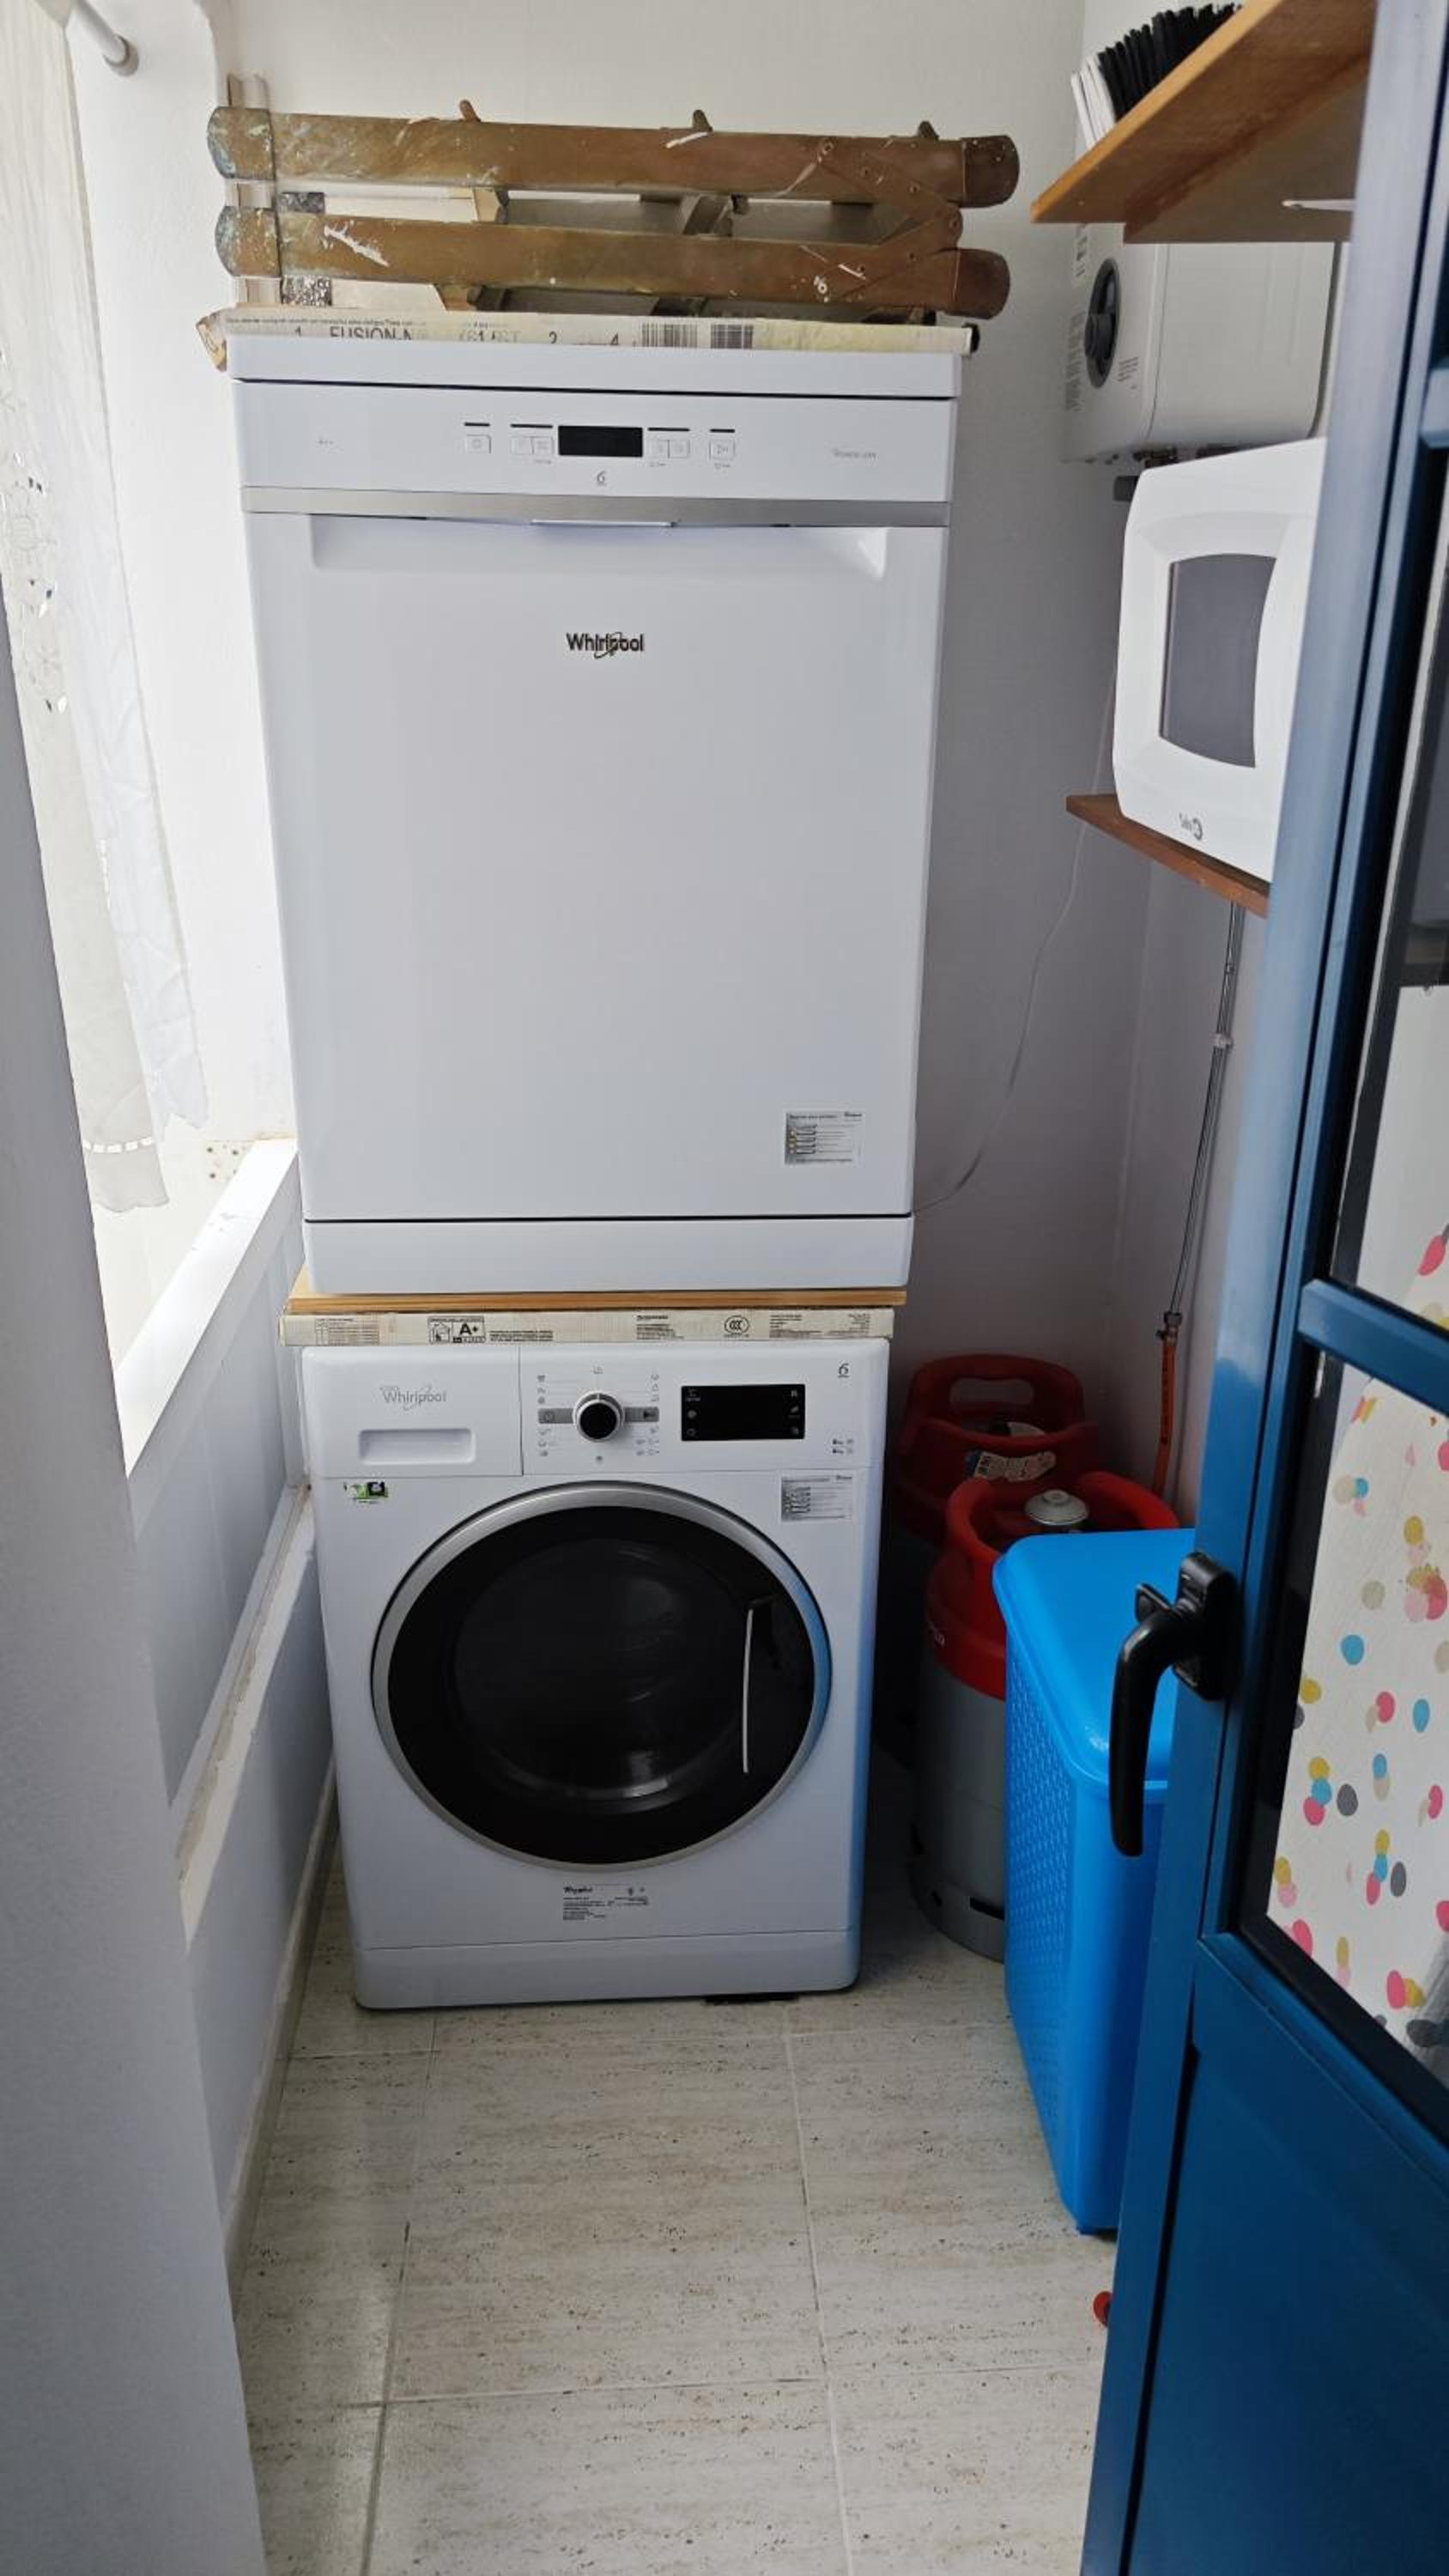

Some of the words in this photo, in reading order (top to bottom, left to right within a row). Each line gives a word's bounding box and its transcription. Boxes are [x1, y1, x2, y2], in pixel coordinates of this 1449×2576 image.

[566, 632, 644, 656] Whirlpool
[459, 1323, 477, 1335] A+
[381, 1387, 446, 1407] Whirlpool
